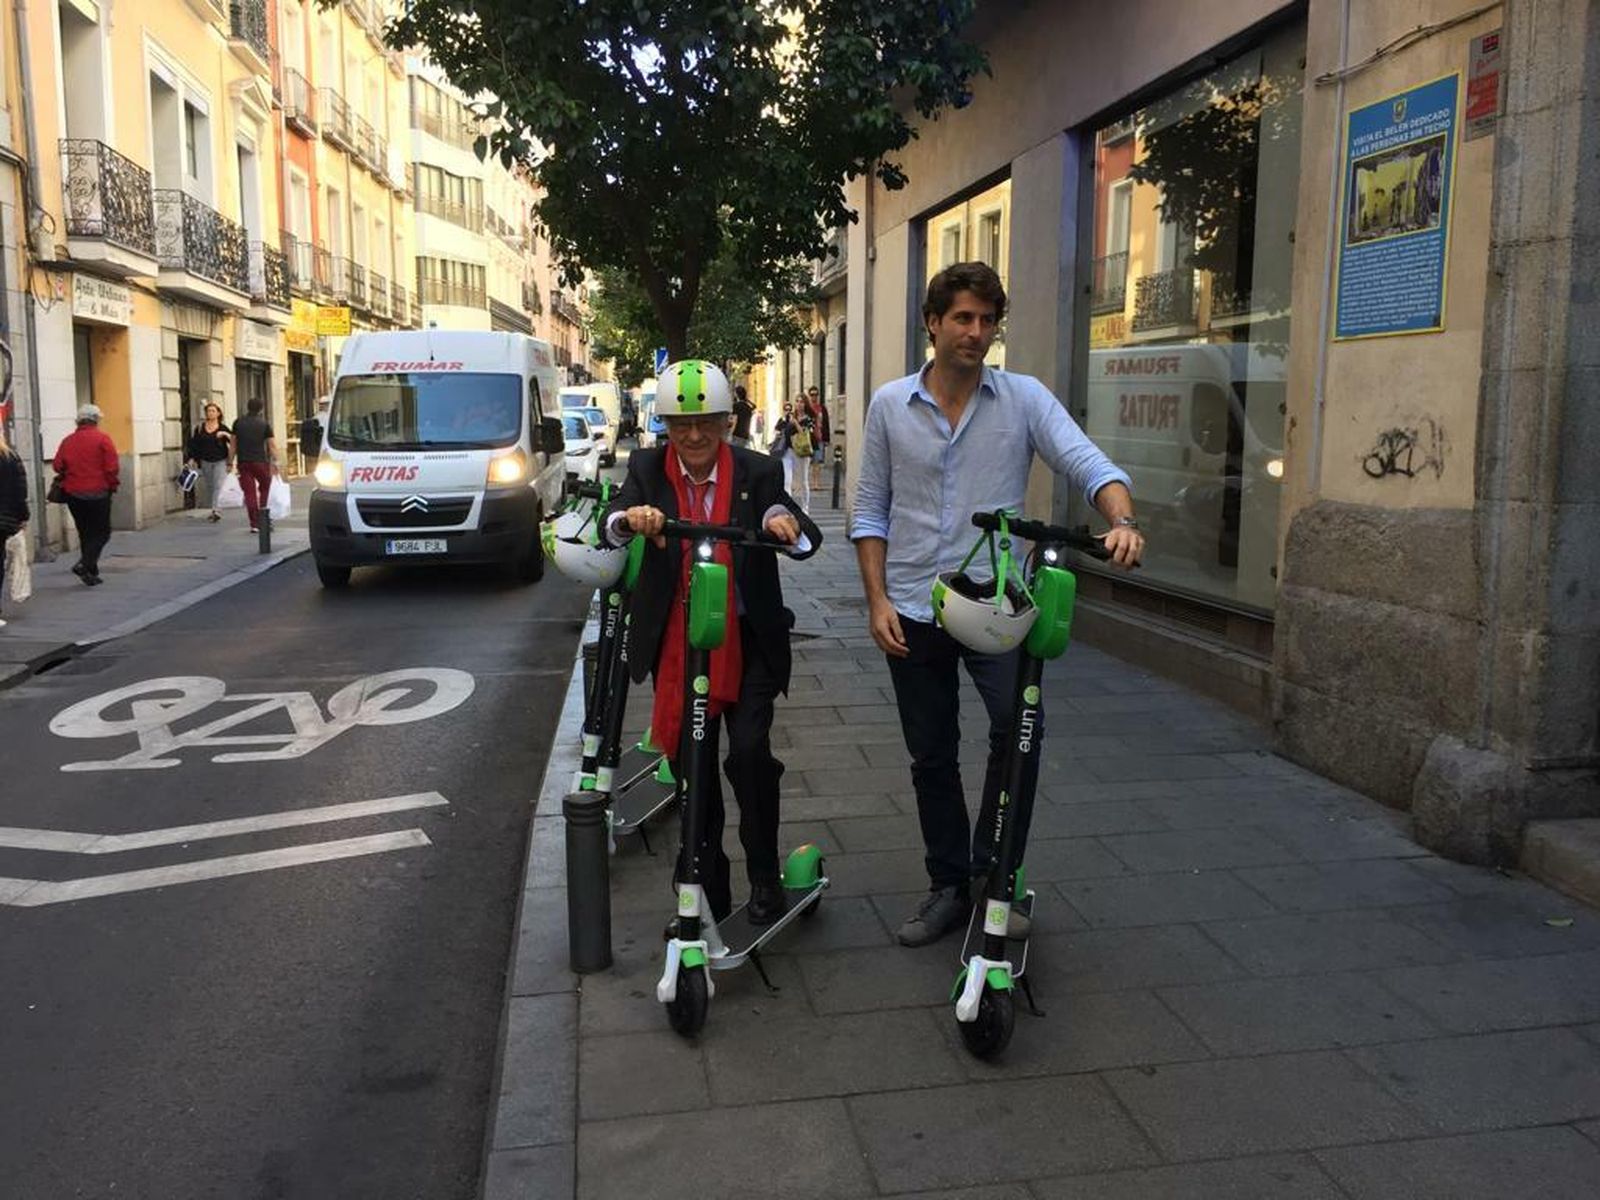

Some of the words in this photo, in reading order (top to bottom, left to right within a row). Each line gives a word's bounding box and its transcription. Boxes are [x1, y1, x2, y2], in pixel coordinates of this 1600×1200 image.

[1353, 133, 1374, 147] VISITA
[1375, 130, 1383, 141] EL
[1410, 108, 1451, 127] DEDICADO
[1356, 145, 1370, 155] LAS
[1370, 135, 1409, 151] PERSONAS
[1410, 128, 1423, 140] SIN
[1424, 118, 1452, 134] TECHO
[371, 361, 464, 371] FRUMAR
[350, 466, 419, 483] FRUTAS
[605, 608, 618, 638] Lime
[692, 698, 708, 741] Lime
[1018, 708, 1037, 753] Lime
